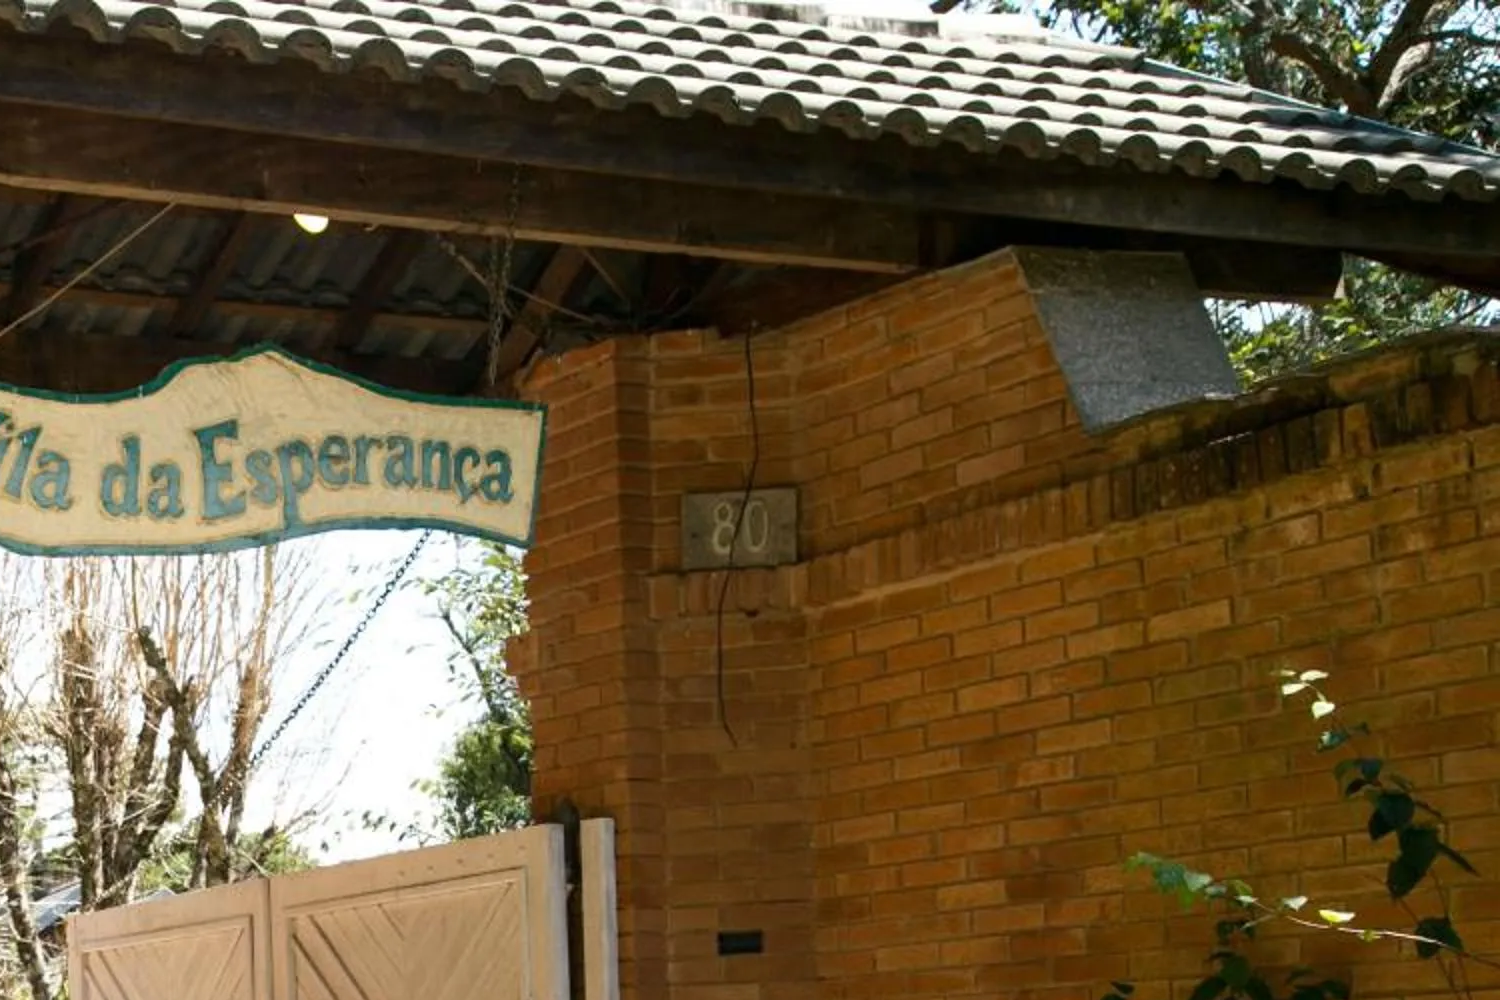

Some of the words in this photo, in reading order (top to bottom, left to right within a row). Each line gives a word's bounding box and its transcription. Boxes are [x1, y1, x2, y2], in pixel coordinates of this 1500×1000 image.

[101, 432, 184, 518] da
[193, 418, 515, 528] Esperança
[713, 500, 768, 555] 80
